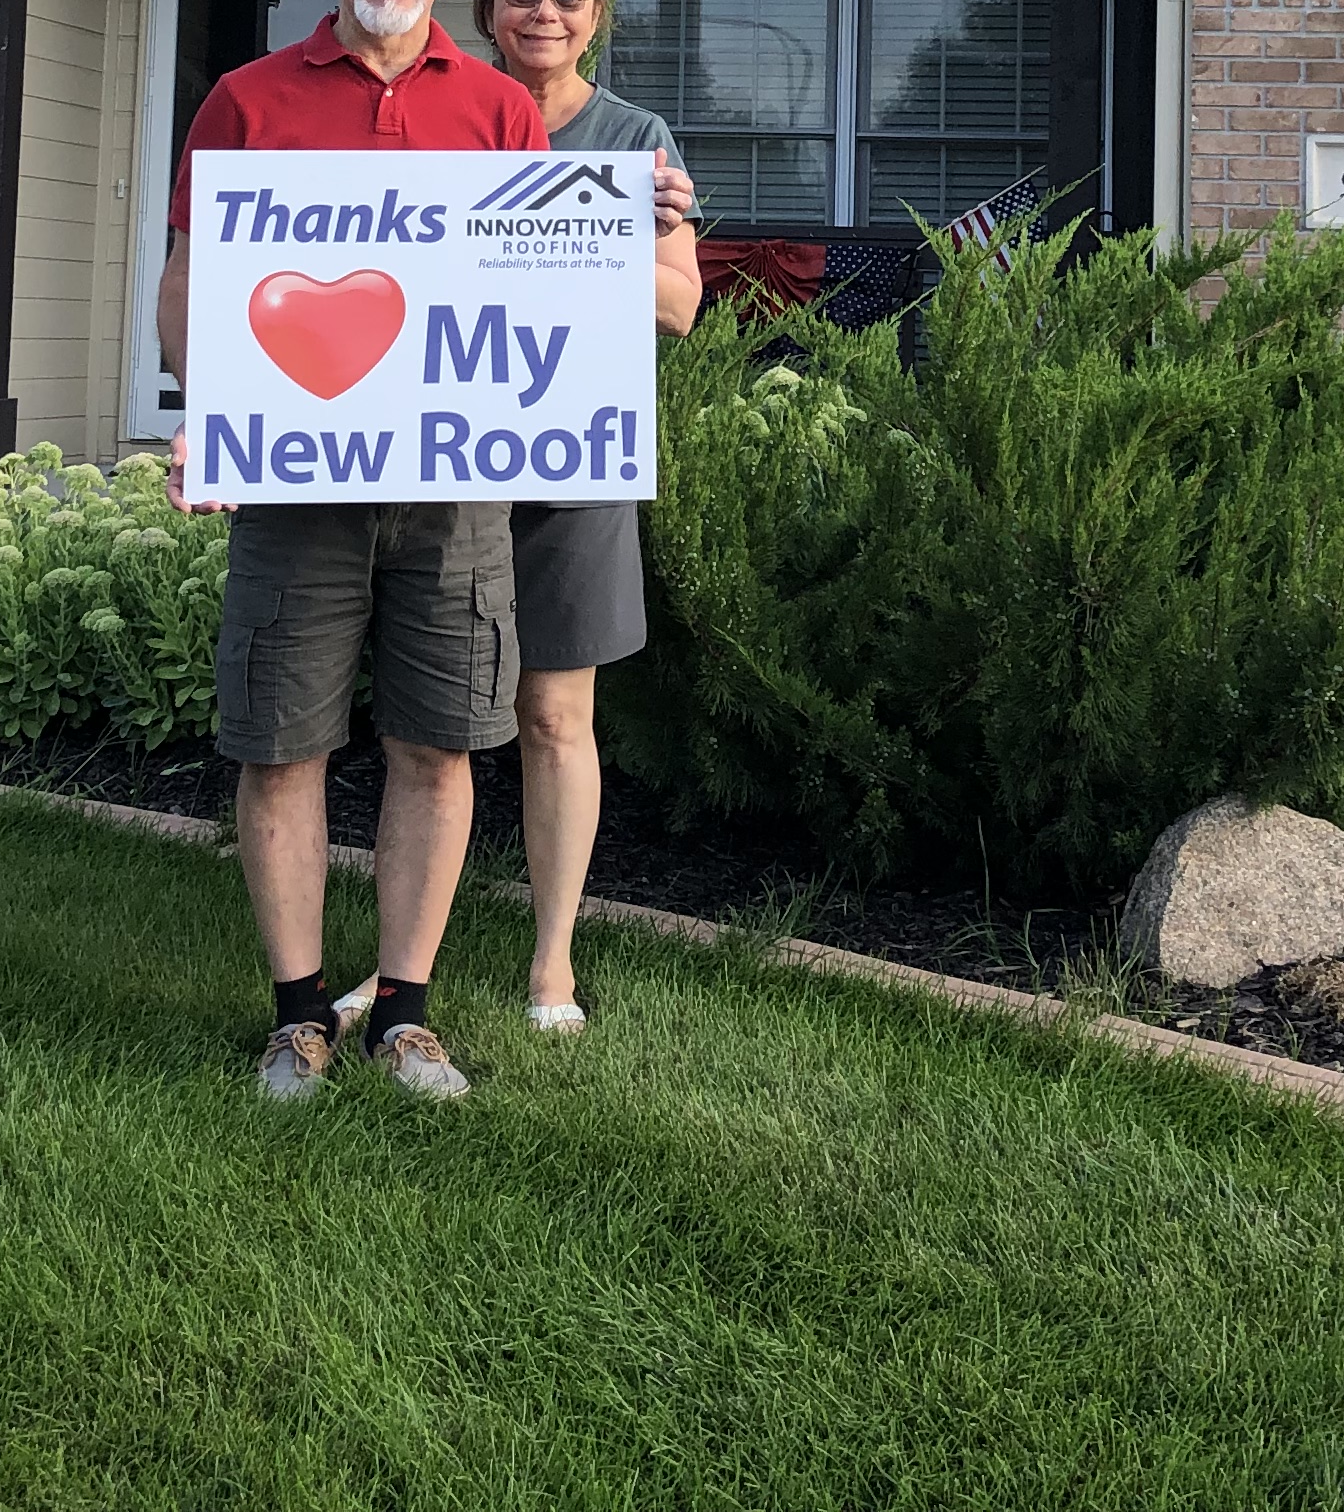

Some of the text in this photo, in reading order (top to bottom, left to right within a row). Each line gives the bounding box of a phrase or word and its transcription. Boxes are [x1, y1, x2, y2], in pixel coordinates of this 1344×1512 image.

[215, 188, 448, 244] Thanks
[466, 218, 634, 237] INNOVATIVE
[478, 257, 626, 272] Reliability Starts at the Top
[502, 240, 600, 255] ROOFING
[422, 304, 571, 409] My
[203, 406, 639, 484] New Roof!
